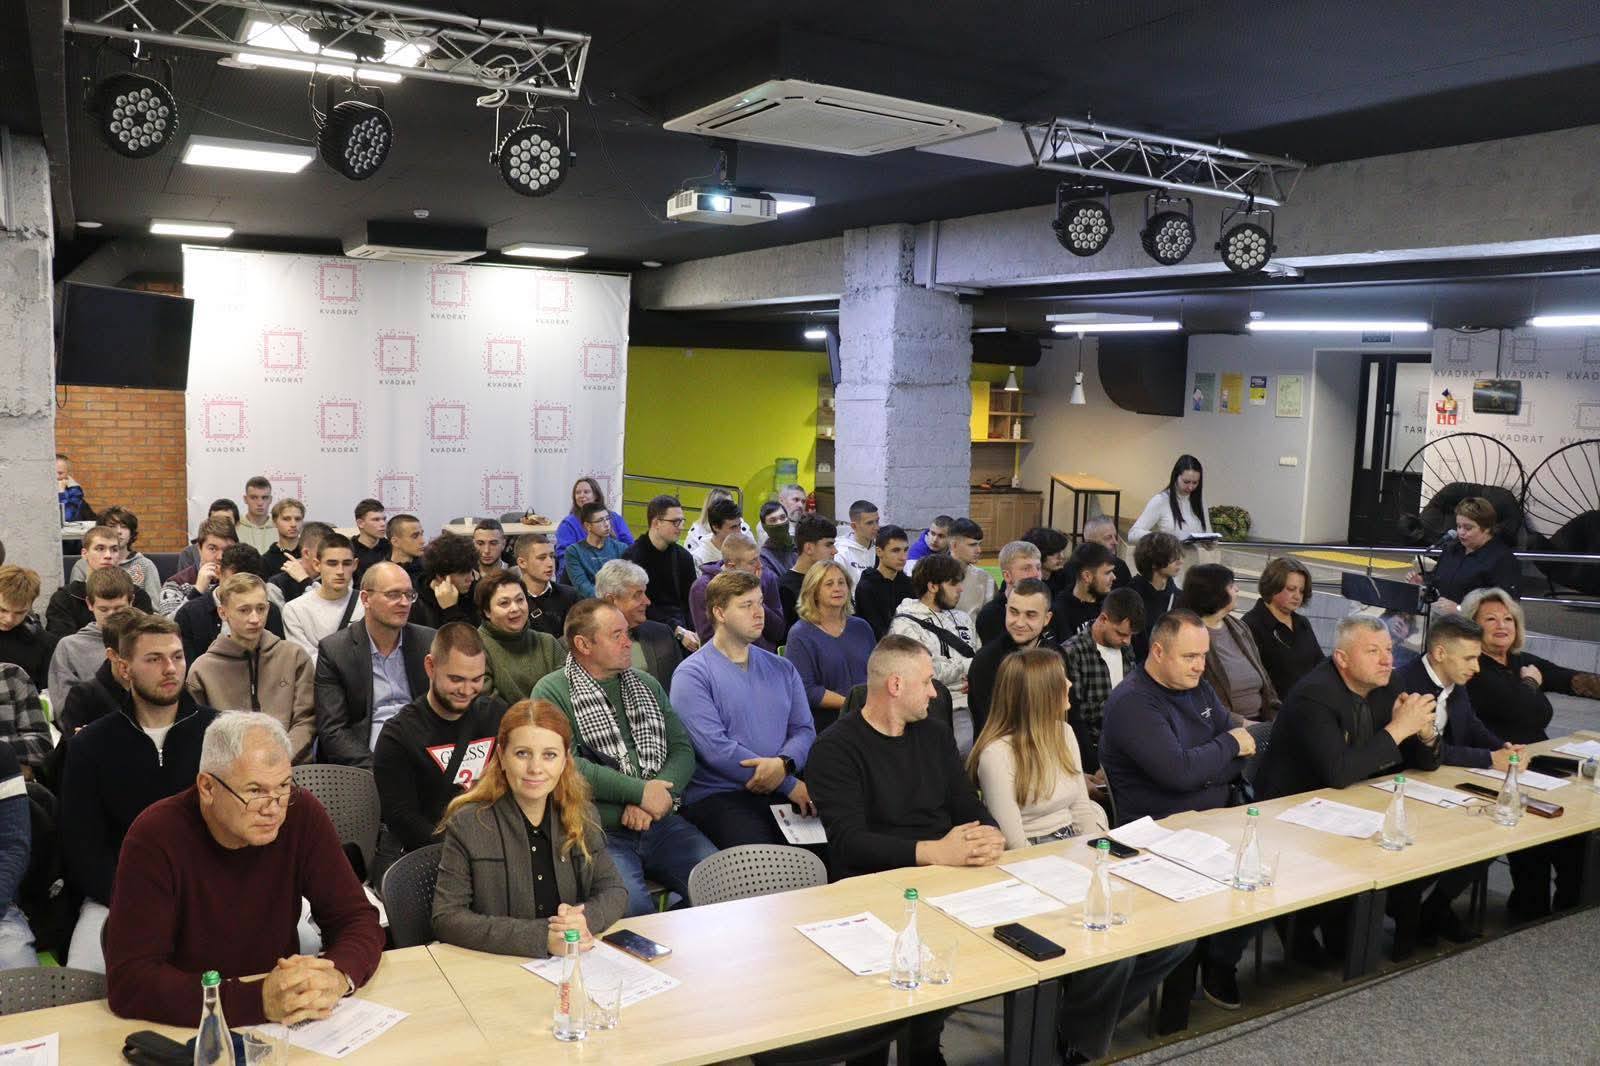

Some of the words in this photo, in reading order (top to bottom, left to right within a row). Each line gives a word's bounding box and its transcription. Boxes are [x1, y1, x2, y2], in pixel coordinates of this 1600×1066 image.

[319, 308, 359, 316] KVADRAT
[430, 312, 467, 320] KVADRAT
[1435, 369, 1482, 378] KVADRAT
[264, 376, 303, 384] KVADRAT
[379, 378, 416, 386] KVADRAT
[487, 381, 522, 389] KVADRAT
[205, 445, 246, 453] KVADRAT
[320, 445, 359, 453] KVADRAT
[430, 446, 467, 454] KVADRAT
[534, 447, 568, 455] KVADRAT
[440, 745, 485, 764] GSS
